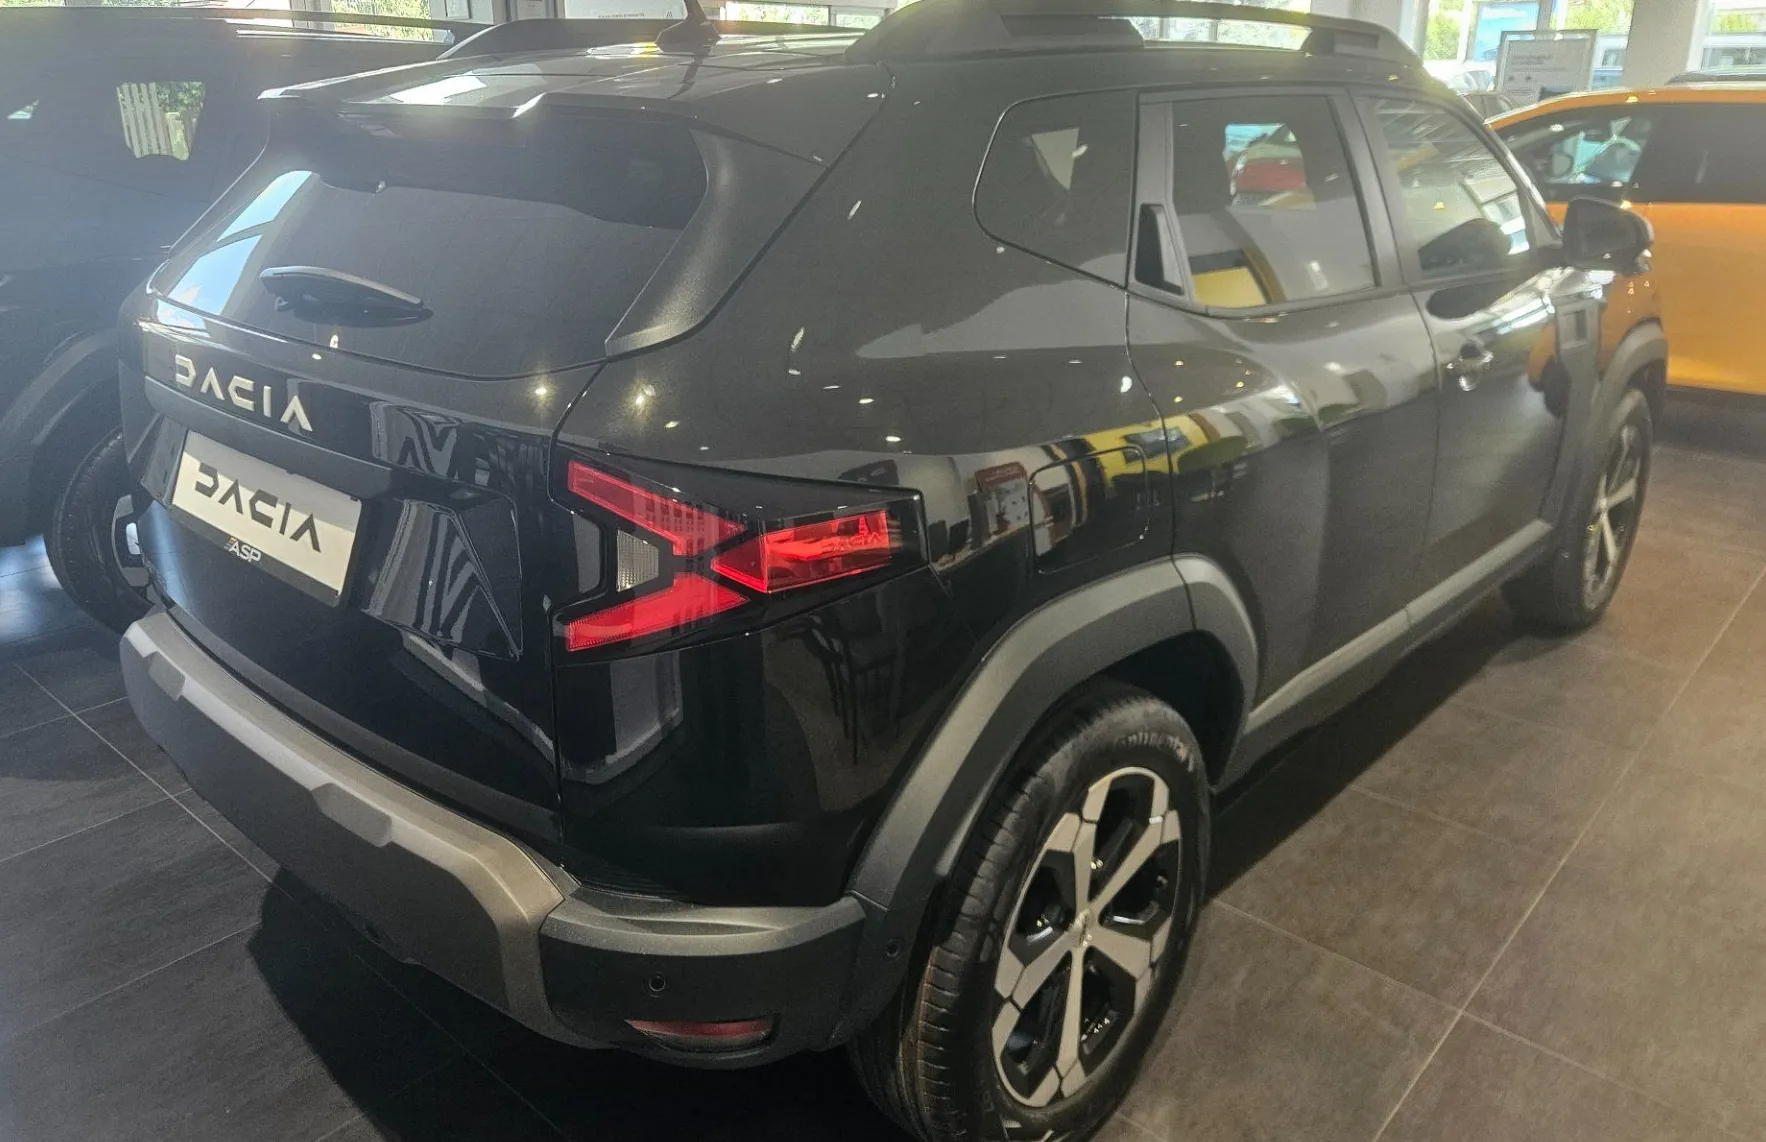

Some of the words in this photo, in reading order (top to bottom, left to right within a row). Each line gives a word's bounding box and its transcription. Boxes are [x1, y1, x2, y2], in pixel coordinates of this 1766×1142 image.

[175, 353, 313, 432] DACIA
[194, 460, 322, 554] DACIA
[228, 540, 262, 562] ASP
